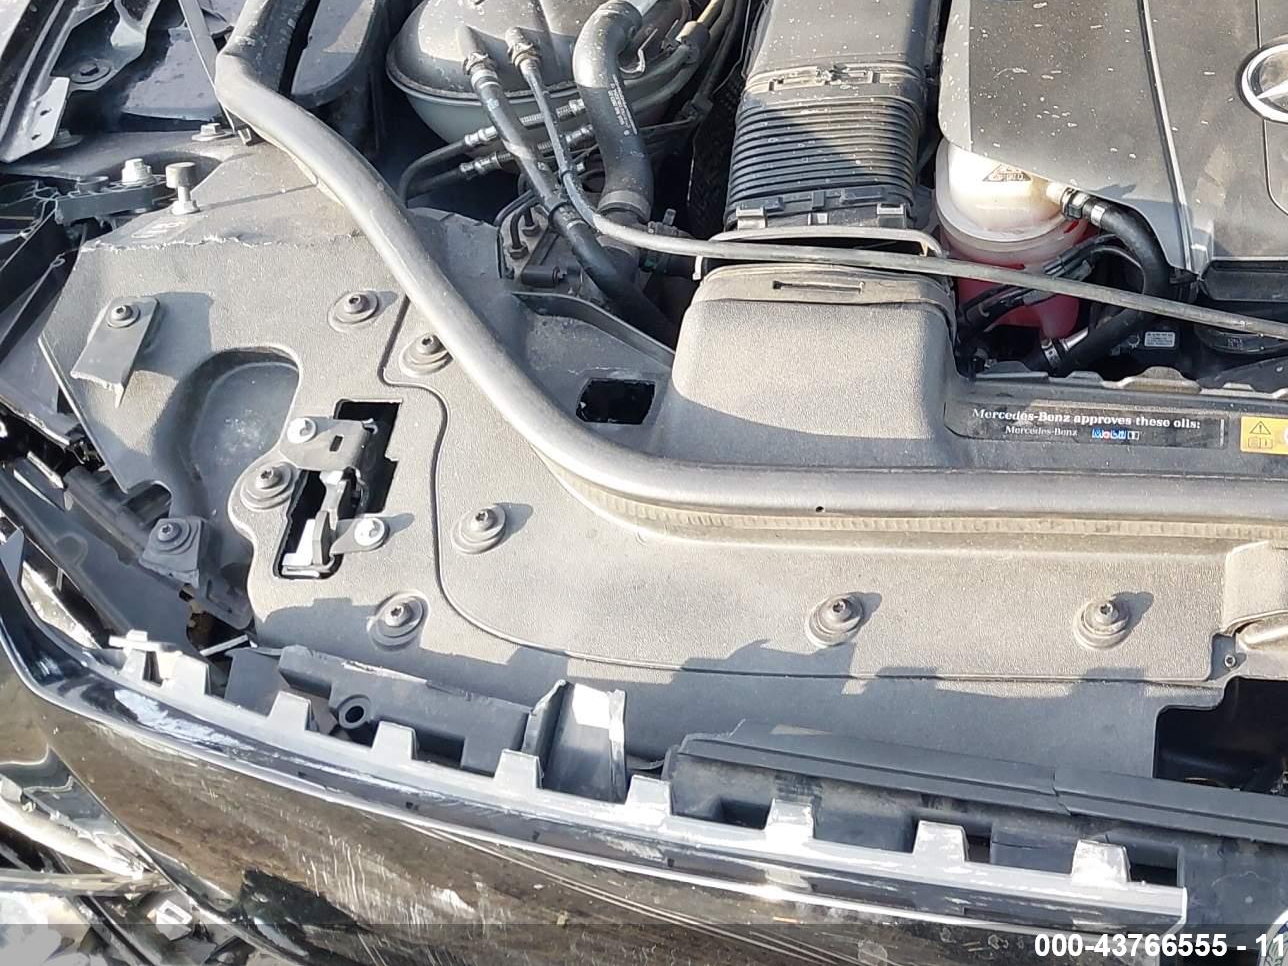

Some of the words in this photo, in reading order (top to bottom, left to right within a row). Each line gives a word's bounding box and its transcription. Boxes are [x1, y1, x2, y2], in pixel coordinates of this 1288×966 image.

[972, 408, 1070, 423] Mercedes-Benz
[1073, 413, 1132, 426] approves
[1135, 416, 1171, 428] these
[1173, 417, 1200, 429] oils:
[1004, 425, 1078, 437] Mercedes-Benz
